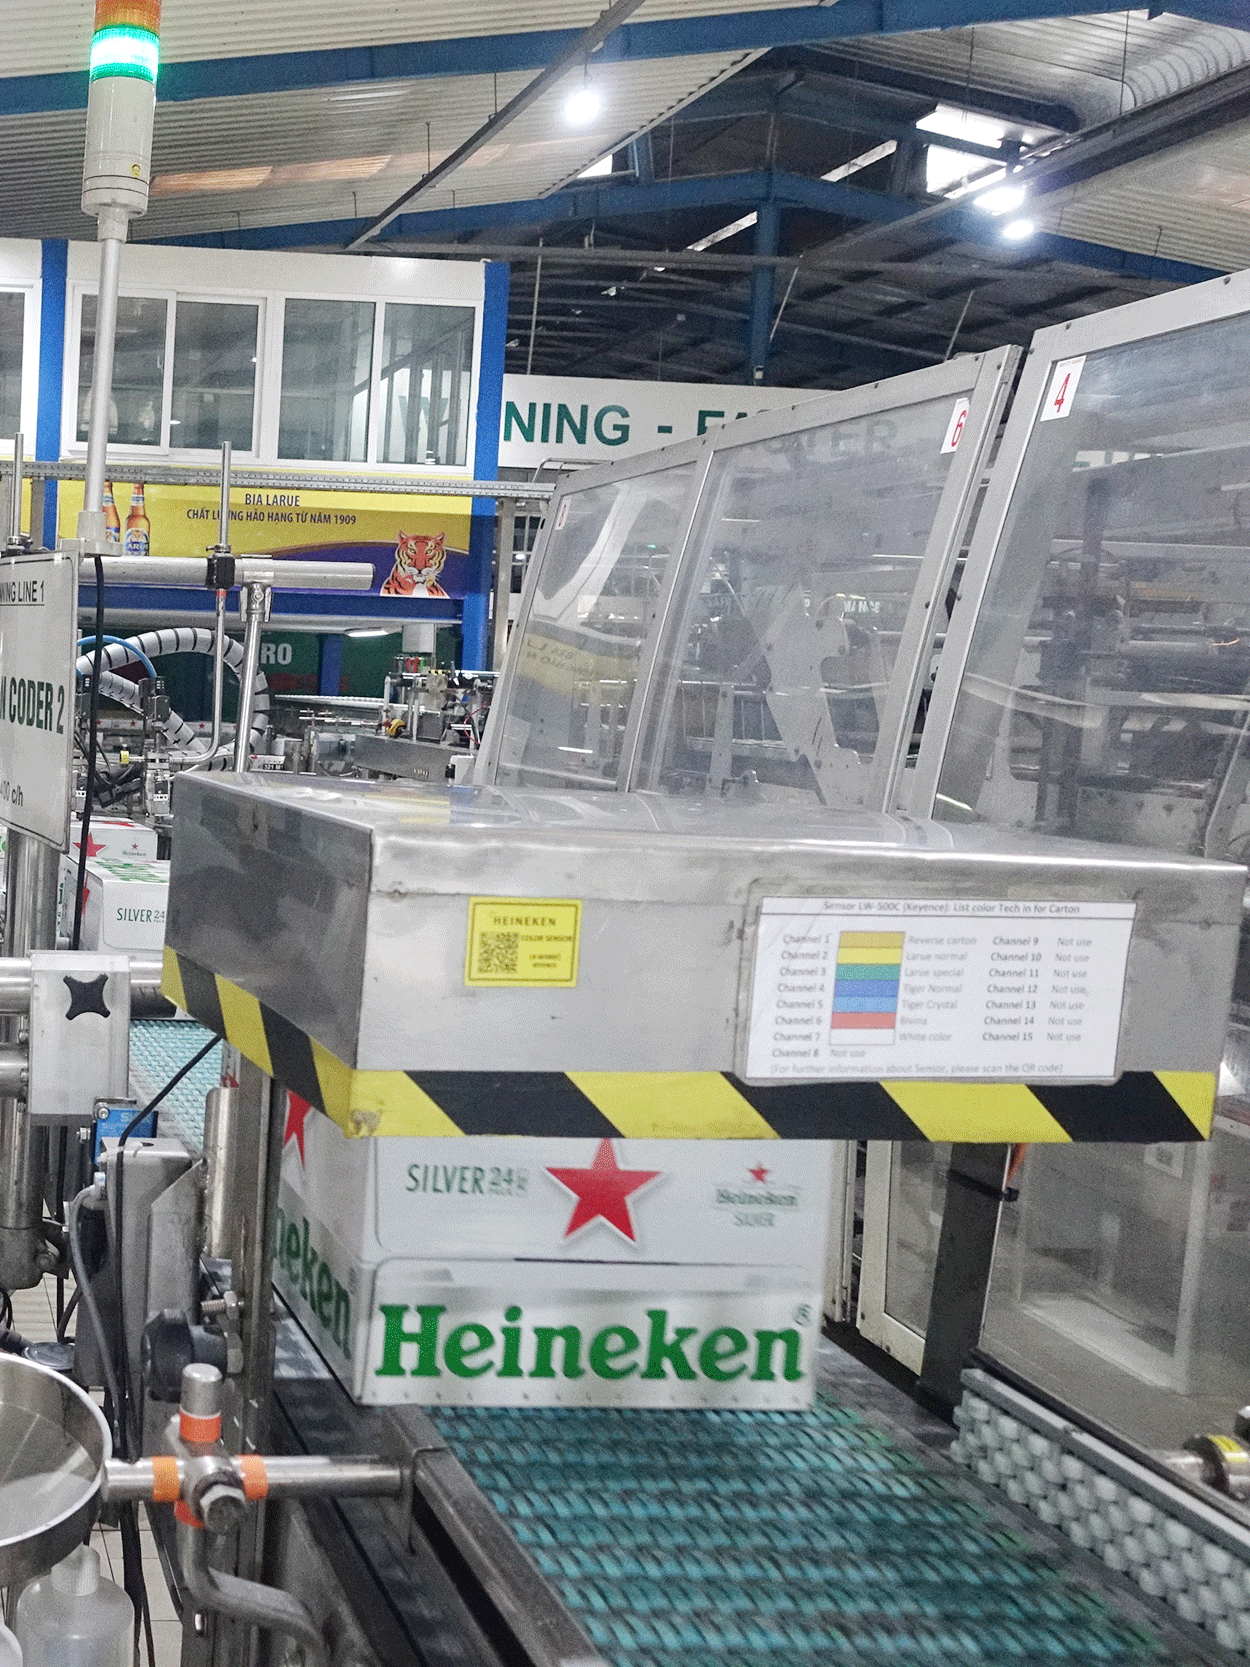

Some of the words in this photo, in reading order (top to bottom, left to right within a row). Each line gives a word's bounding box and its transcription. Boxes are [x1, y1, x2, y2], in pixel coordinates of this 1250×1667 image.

[1054, 372, 1071, 413] 4
[503, 400, 630, 446] NING
[951, 410, 967, 447] 6
[245, 493, 263, 506] BIA
[266, 494, 300, 507] LARUE
[186, 506, 210, 520] CHẤT
[267, 512, 293, 525] HẠNG
[334, 514, 357, 525] 1909
[18, 580, 37, 602] LINE
[40, 580, 45, 602] 1
[8, 676, 54, 732] CODER
[56, 684, 65, 735] 2
[823, 902, 856, 911] Sensor
[953, 903, 969, 912] List
[971, 903, 996, 913] color
[998, 904, 1020, 913] Tech
[1022, 904, 1031, 913] in
[1033, 904, 1047, 913] for
[1049, 905, 1080, 913] Carton
[116, 907, 153, 923] SILVER
[153, 909, 165, 919] 24
[493, 916, 556, 927] HEINEKEN
[783, 934, 821, 944] Channel
[992, 936, 1030, 946] Channel
[1032, 937, 1039, 946] 9
[1057, 938, 1074, 947] Not
[1076, 939, 1092, 947] use
[781, 951, 819, 960] Channel
[990, 952, 1028, 962] Channel
[1030, 952, 1042, 962] 10
[1054, 953, 1072, 963] Not
[1073, 955, 1090, 963] use
[779, 966, 818, 976] Channel
[989, 968, 1026, 978] Channel
[1028, 968, 1039, 978] 11
[1053, 969, 1070, 978] Not
[777, 983, 817, 992] Channel
[987, 984, 1024, 994] Channel
[1027, 984, 1038, 994] 12
[1051, 985, 1069, 994] Not
[1071, 986, 1086, 994] use
[776, 999, 815, 1009] Channel
[985, 1000, 1023, 1010] Channel
[1026, 1000, 1036, 1010] 13
[1050, 1001, 1067, 1010] Not
[1068, 1002, 1085, 1010] use
[775, 1015, 813, 1025] Channel
[983, 1016, 1021, 1026] Channel
[1024, 1016, 1035, 1026] 14
[1048, 1016, 1066, 1026] Not
[1067, 1018, 1083, 1026] use
[773, 1032, 812, 1042] Channel
[982, 1032, 1020, 1042] Channel
[1022, 1032, 1033, 1042] 15
[1046, 1032, 1064, 1041] Not
[1066, 1034, 1082, 1042] use
[772, 1048, 811, 1057] Channel
[951, 1064, 981, 1075] please
[982, 1065, 1003, 1074] scan
[1005, 1064, 1020, 1073] the
[1021, 1064, 1035, 1074] QR
[405, 1163, 486, 1194] SILVER
[374, 1304, 805, 1383] Heineken
